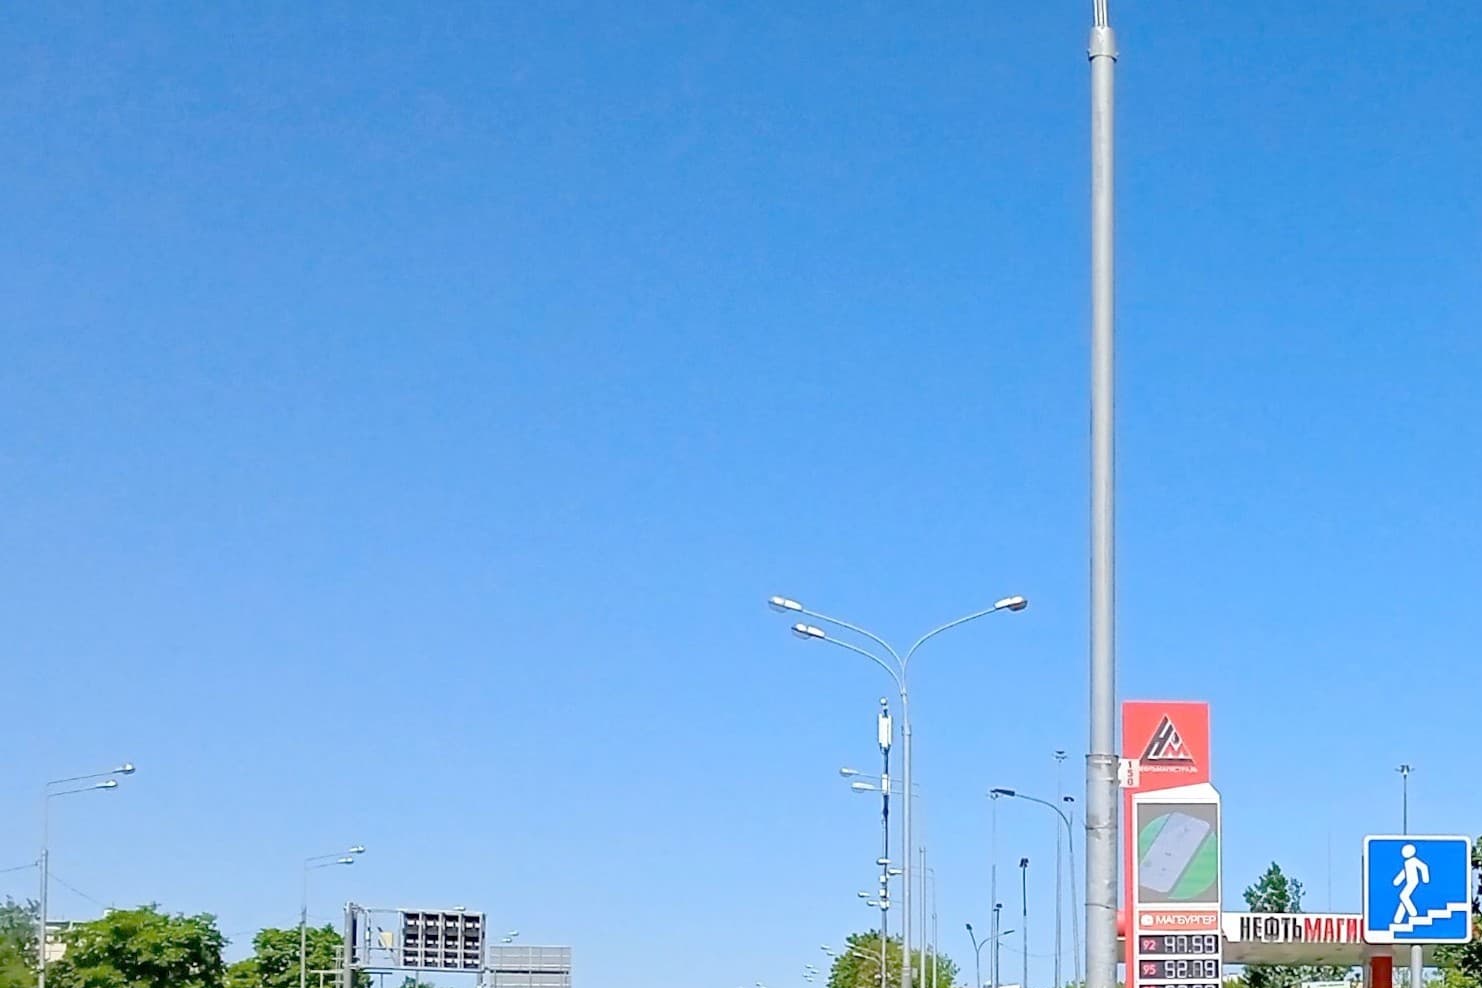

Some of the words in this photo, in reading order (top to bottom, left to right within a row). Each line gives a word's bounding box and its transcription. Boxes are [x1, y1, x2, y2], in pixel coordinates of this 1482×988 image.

[1143, 940, 1156, 951] 92
[1164, 935, 1216, 954] 47.59
[1143, 965, 1156, 975] 95
[1164, 960, 1216, 979] 52.79
